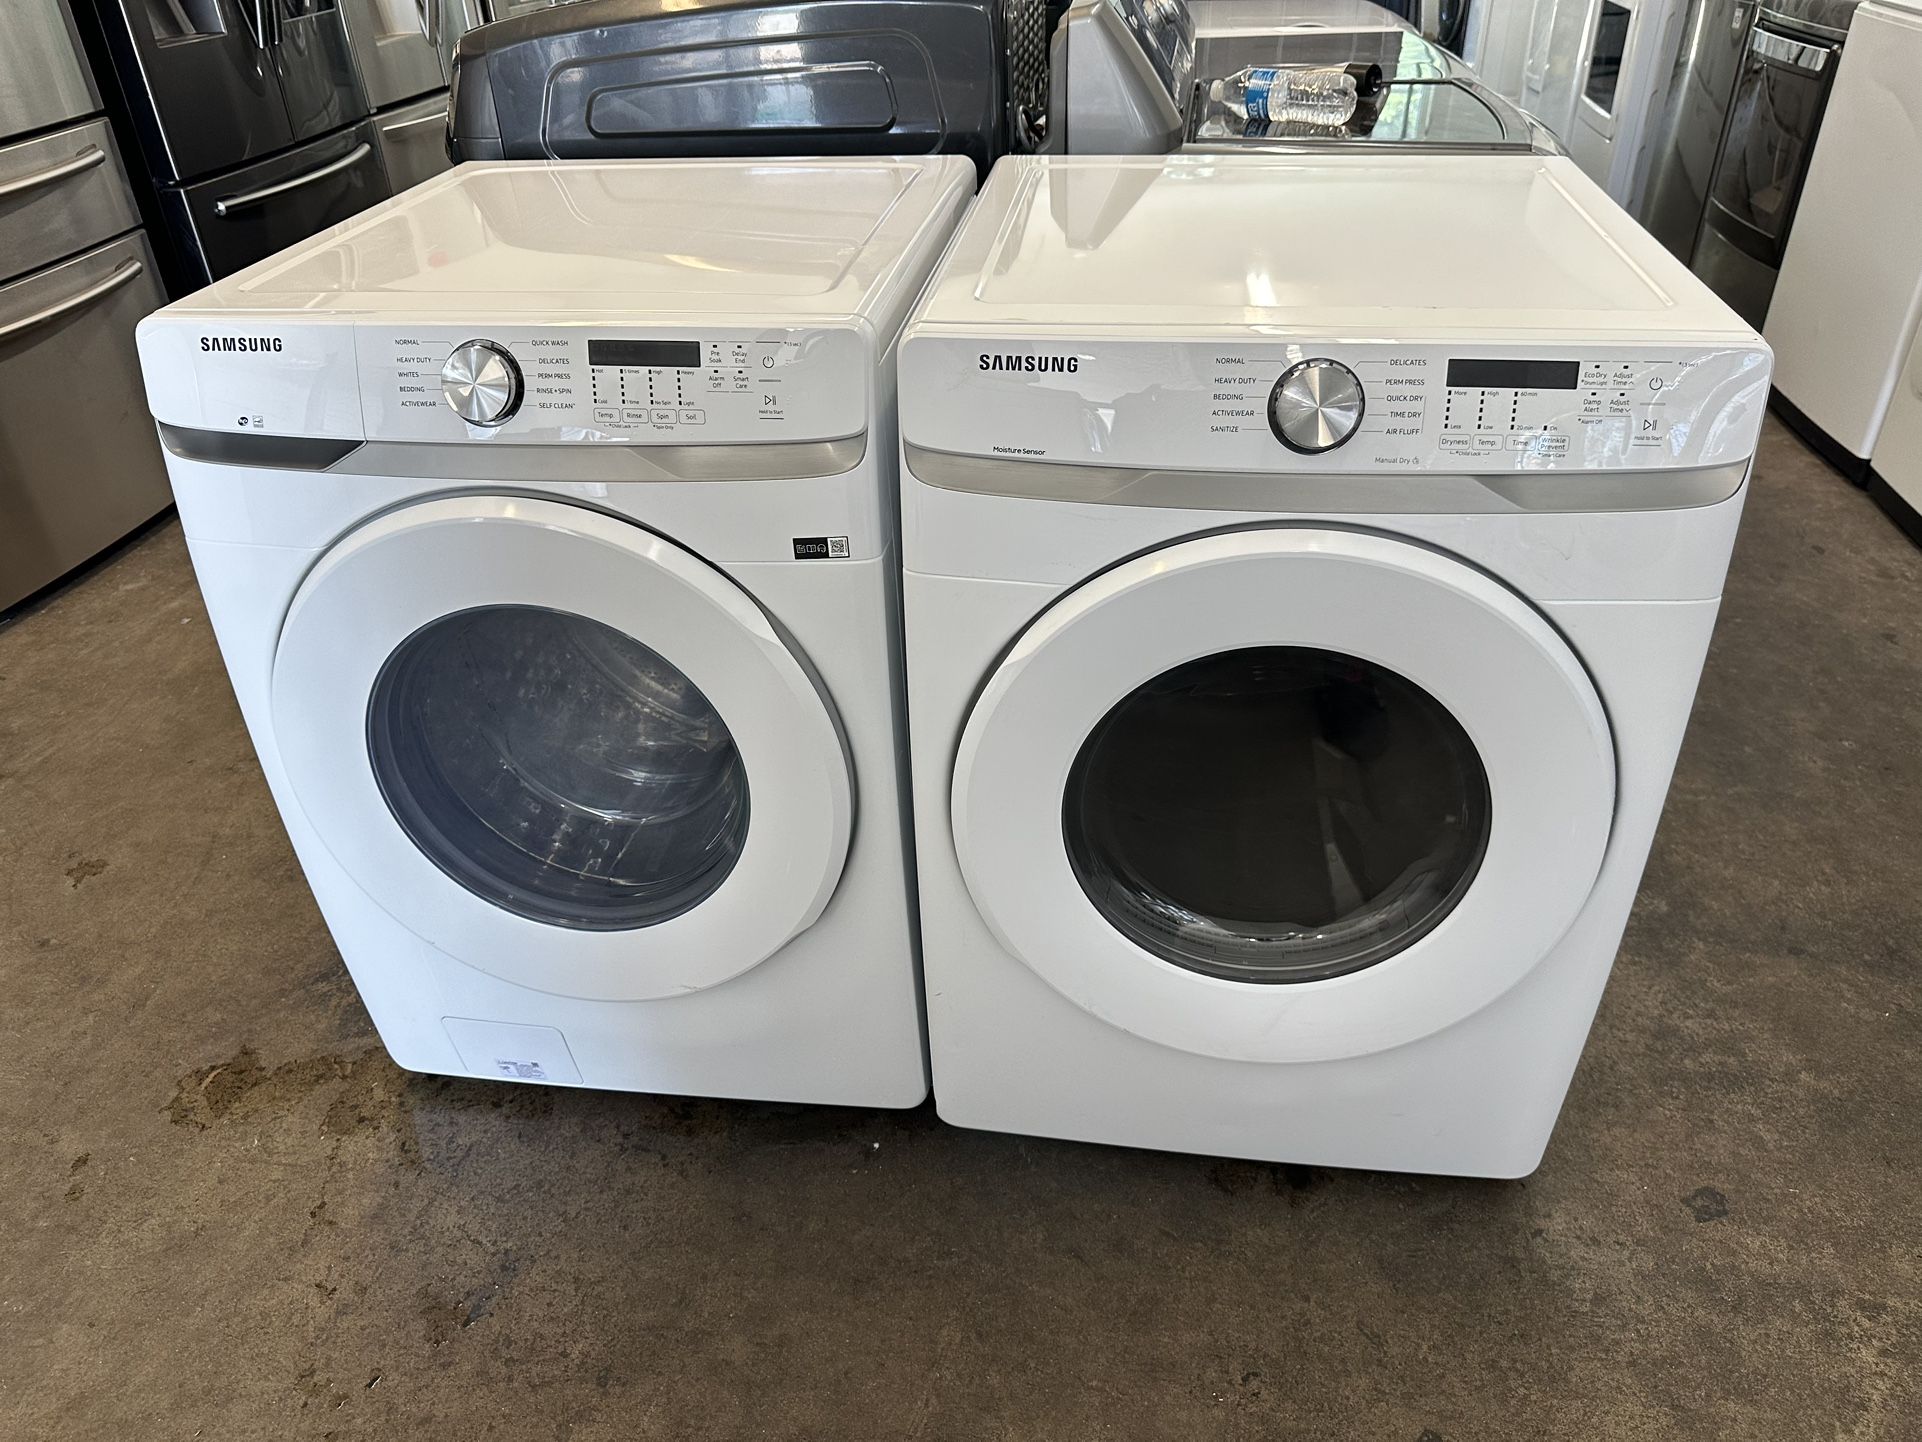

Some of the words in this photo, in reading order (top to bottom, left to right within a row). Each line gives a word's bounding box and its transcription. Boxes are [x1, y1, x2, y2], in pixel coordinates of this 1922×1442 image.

[201, 337, 282, 352] SAMSUNG
[732, 350, 748, 358] Delay
[979, 354, 1079, 373] SAMSUNG
[1613, 372, 1633, 380] Adjust
[1584, 398, 1602, 406] Damp
[1610, 399, 1630, 407] Adjust
[598, 412, 616, 420] Temp.
[1442, 438, 1468, 446] Dryness
[993, 446, 1022, 454] Moisture
